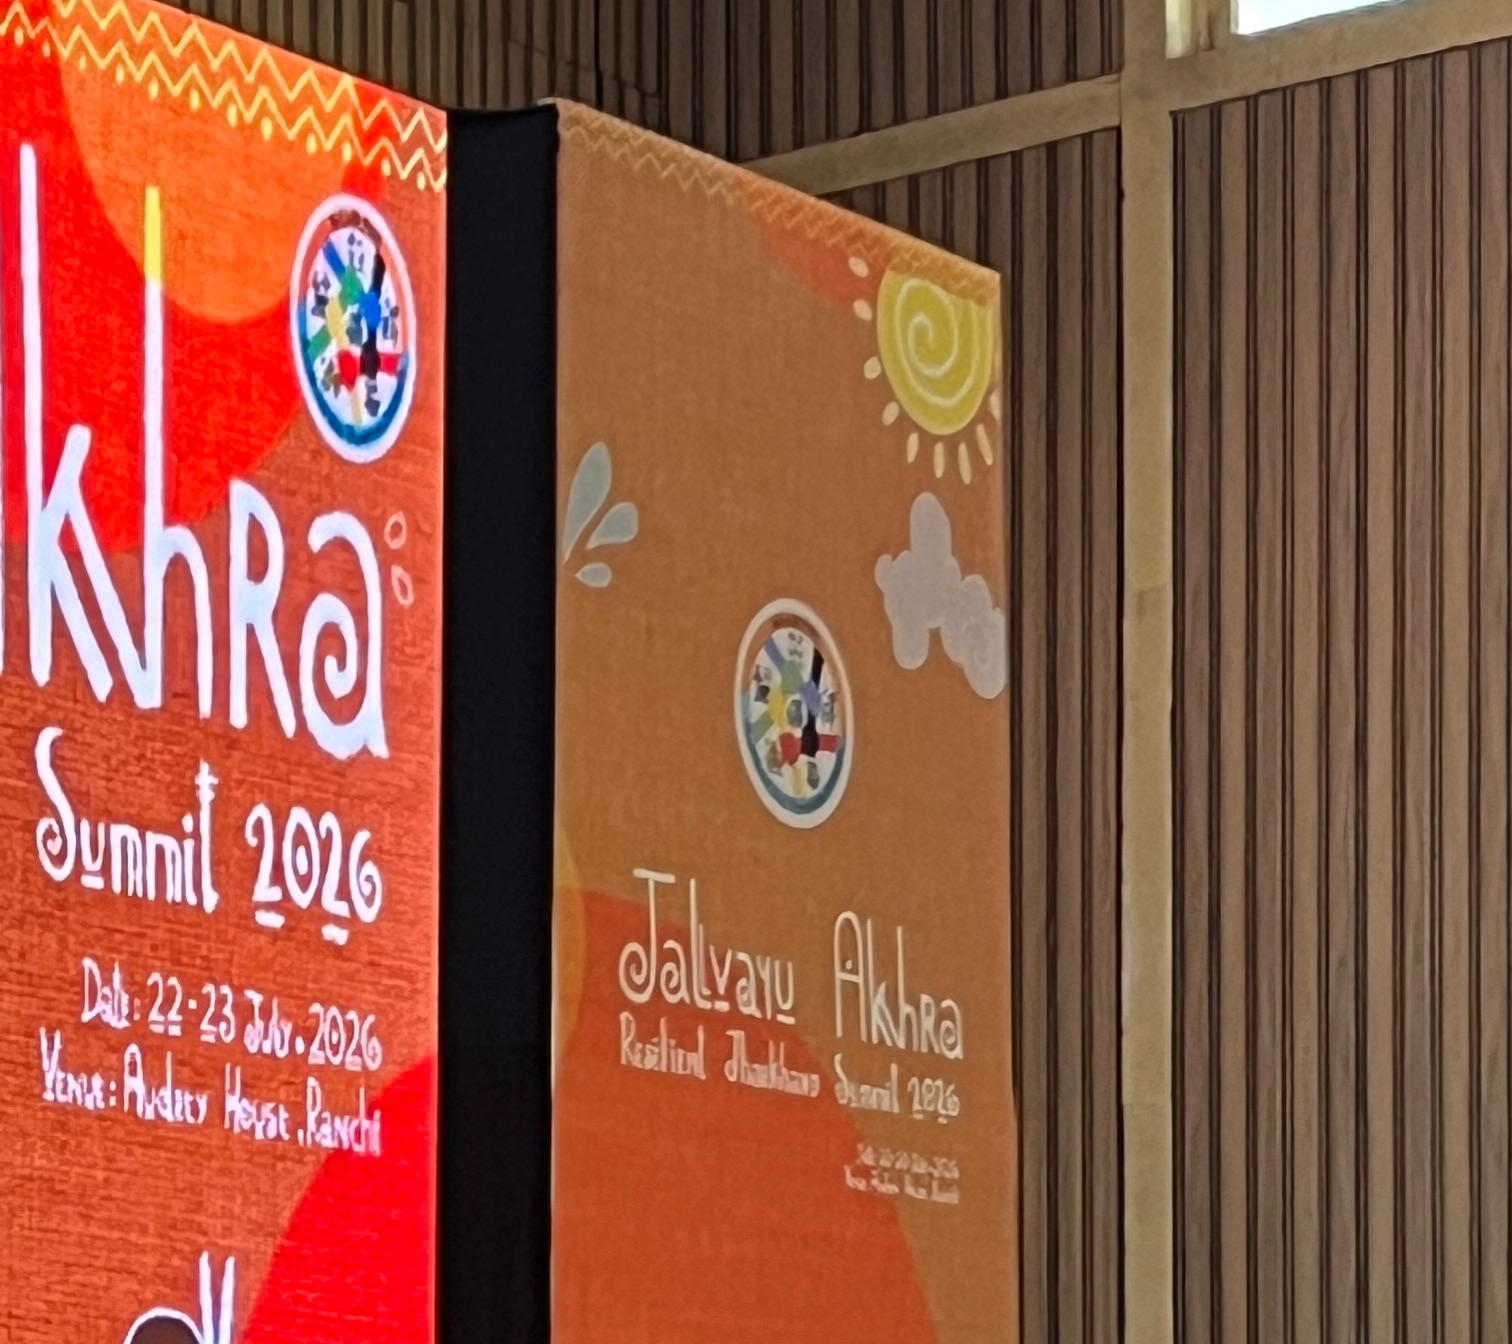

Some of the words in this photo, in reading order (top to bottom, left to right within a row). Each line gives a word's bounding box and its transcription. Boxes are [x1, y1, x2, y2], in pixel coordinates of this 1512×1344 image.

[34, 725, 219, 913] Summit
[245, 804, 383, 944] 2026
[146, 971, 236, 1044] 22-23
[907, 1076, 961, 1124] 2026
